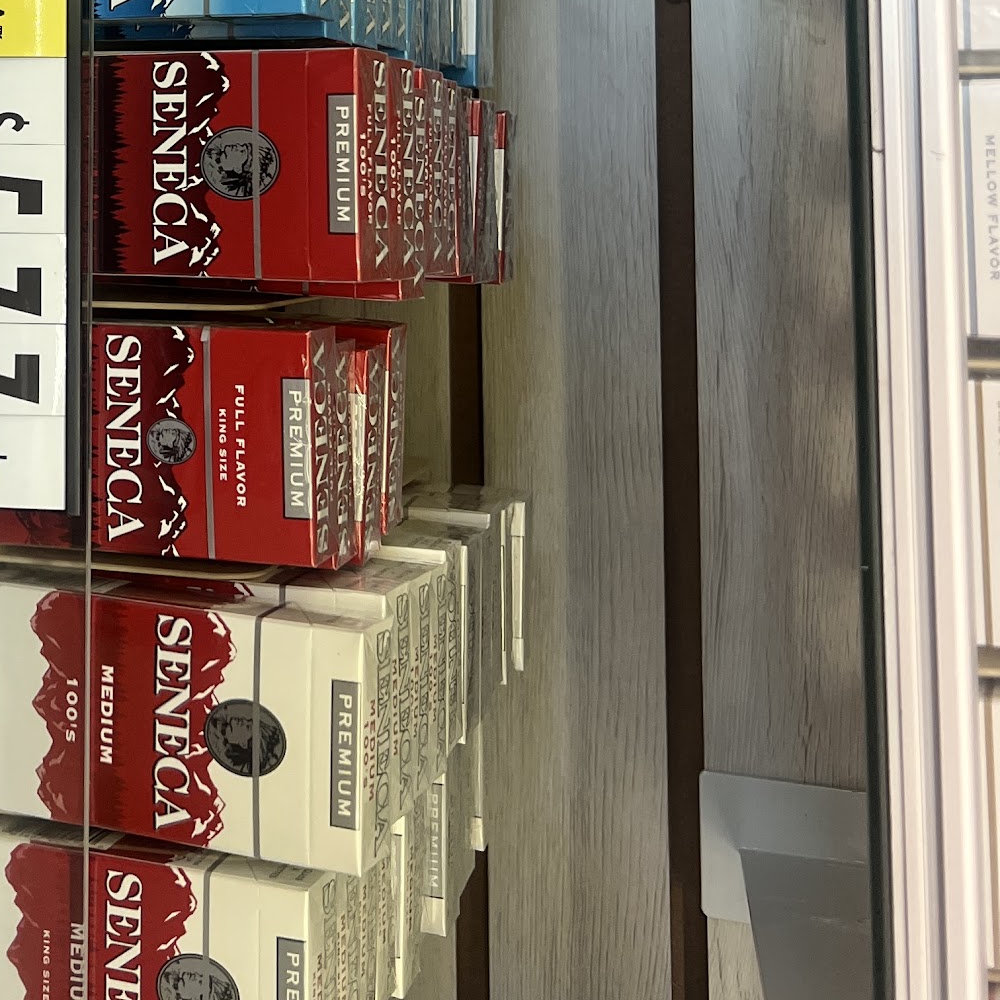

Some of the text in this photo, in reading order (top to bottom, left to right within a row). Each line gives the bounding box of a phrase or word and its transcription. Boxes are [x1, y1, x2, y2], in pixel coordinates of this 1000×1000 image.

[152, 61, 189, 266] SENECA
[335, 105, 350, 223] PREMIUM
[985, 134, 1000, 281] MELLOW FLAVOR
[105, 334, 144, 542] SENECA
[219, 448, 228, 481] SIZE
[235, 385, 246, 507] FULL FLAVOR
[288, 390, 303, 508] PREMIUM
[99, 664, 114, 765] MEDIUM
[153, 614, 192, 831] SENECA
[338, 694, 352, 817] PREMIUM
